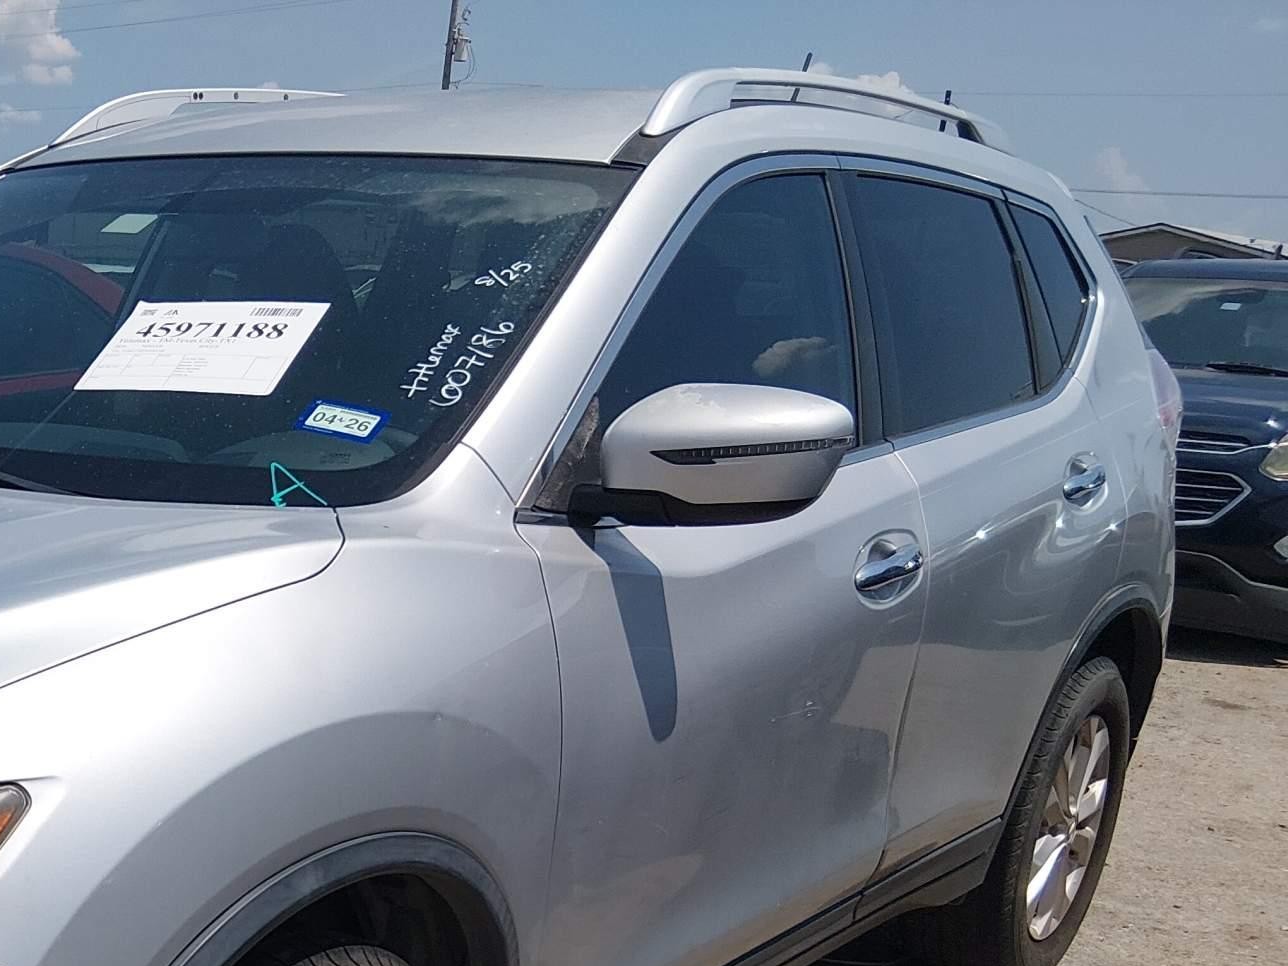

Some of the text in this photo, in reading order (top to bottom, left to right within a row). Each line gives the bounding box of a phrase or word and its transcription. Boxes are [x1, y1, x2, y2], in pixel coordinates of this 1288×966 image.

[475, 261, 532, 287] 8/25
[136, 322, 288, 339] 45971188
[313, 411, 338, 425] 04
[344, 418, 371, 432] 26
[271, 462, 328, 508] A
